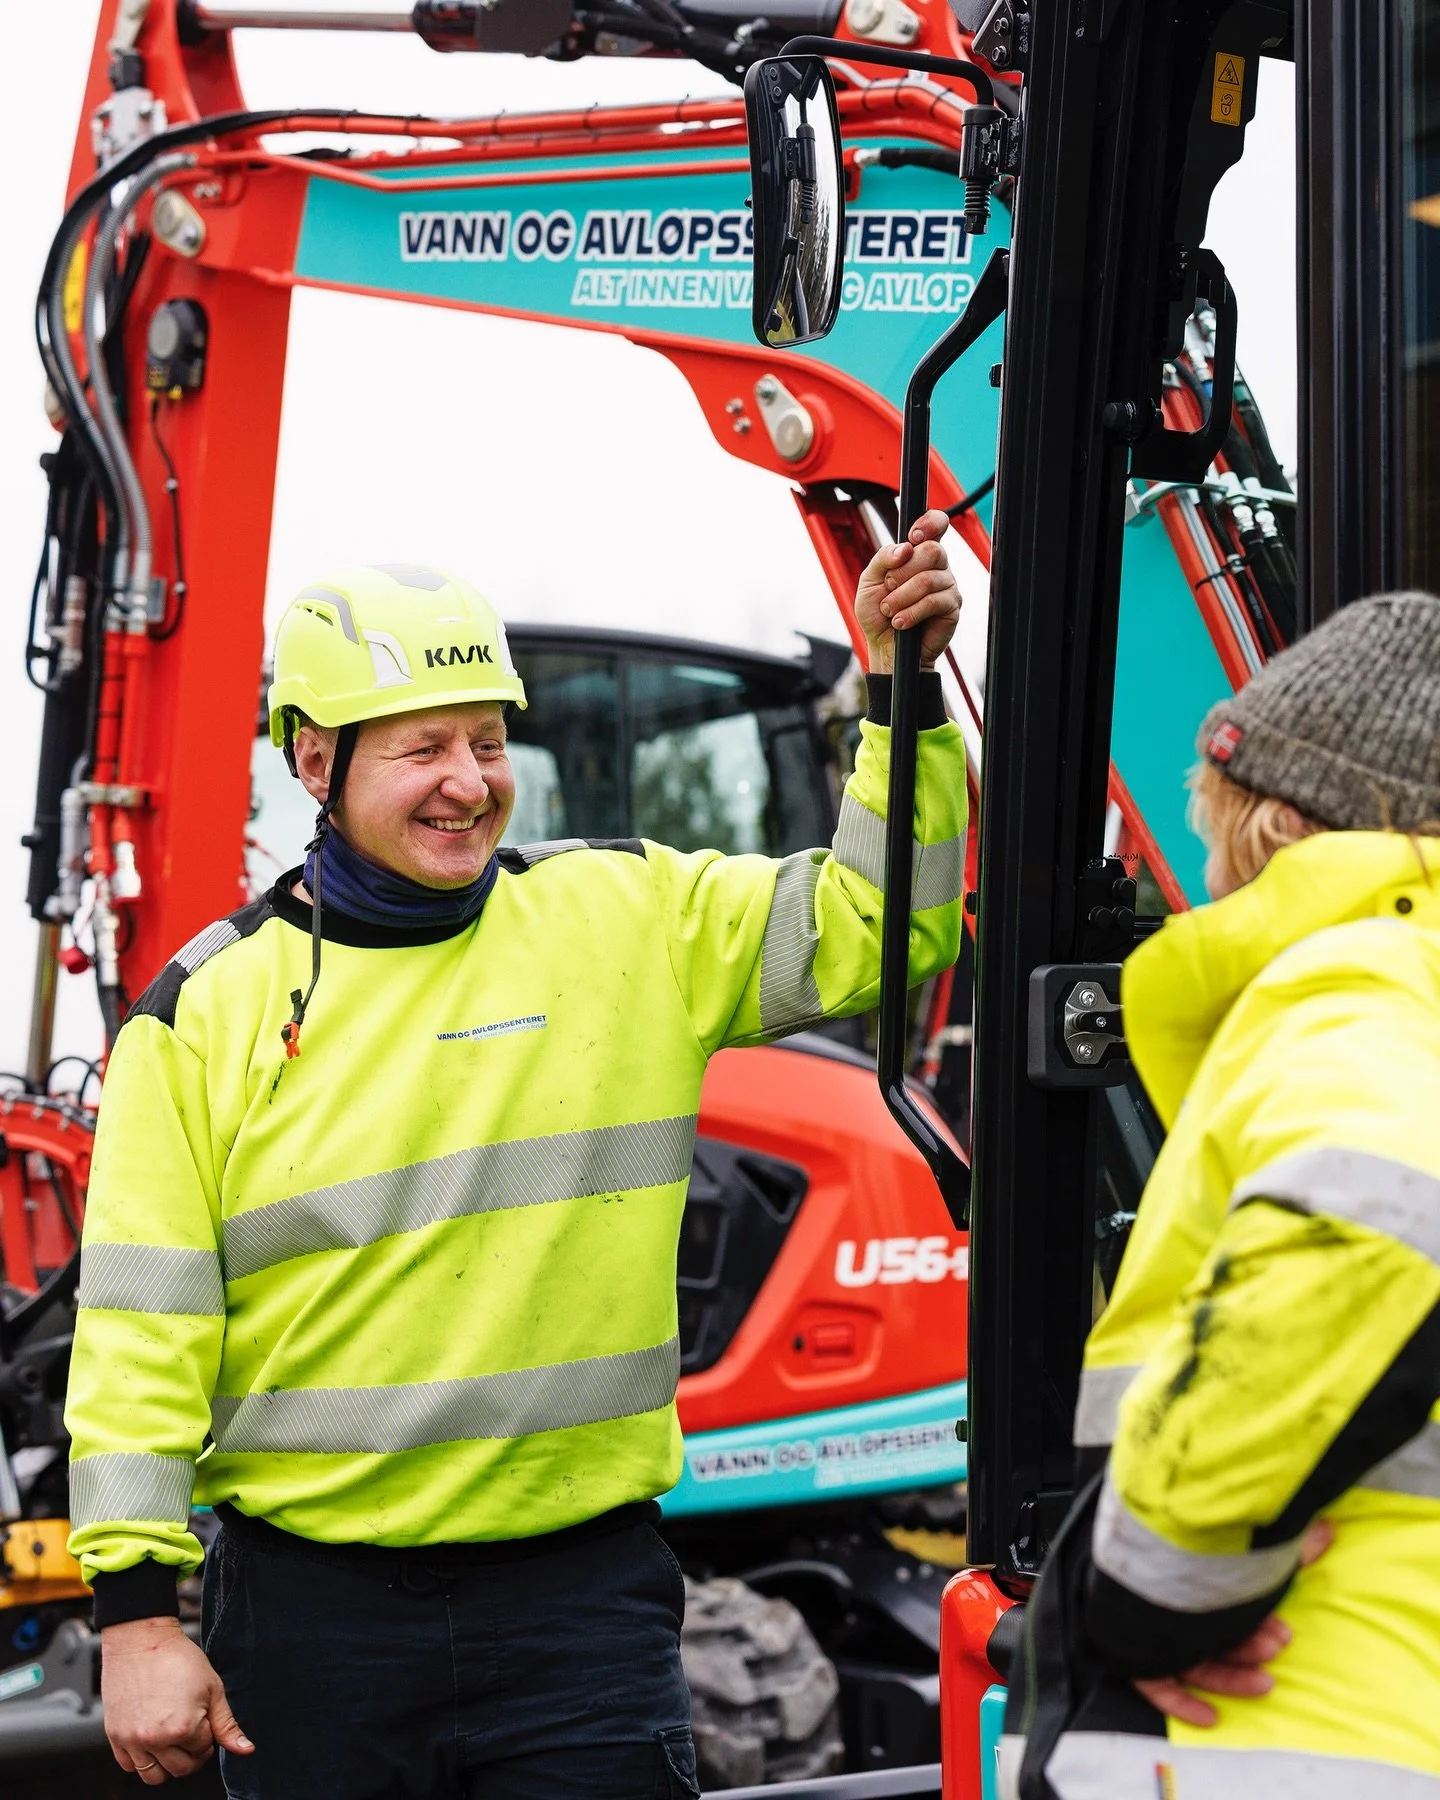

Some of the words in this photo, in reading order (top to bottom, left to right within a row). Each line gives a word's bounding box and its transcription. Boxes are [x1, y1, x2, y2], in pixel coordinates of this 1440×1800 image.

[402, 213, 509, 258] VANN
[515, 212, 574, 259] OG
[573, 271, 626, 304] ALT
[628, 271, 721, 305] INNEN
[425, 645, 493, 668] KASK
[436, 1032, 457, 1041] VANN
[691, 1450, 771, 1477] VANN
